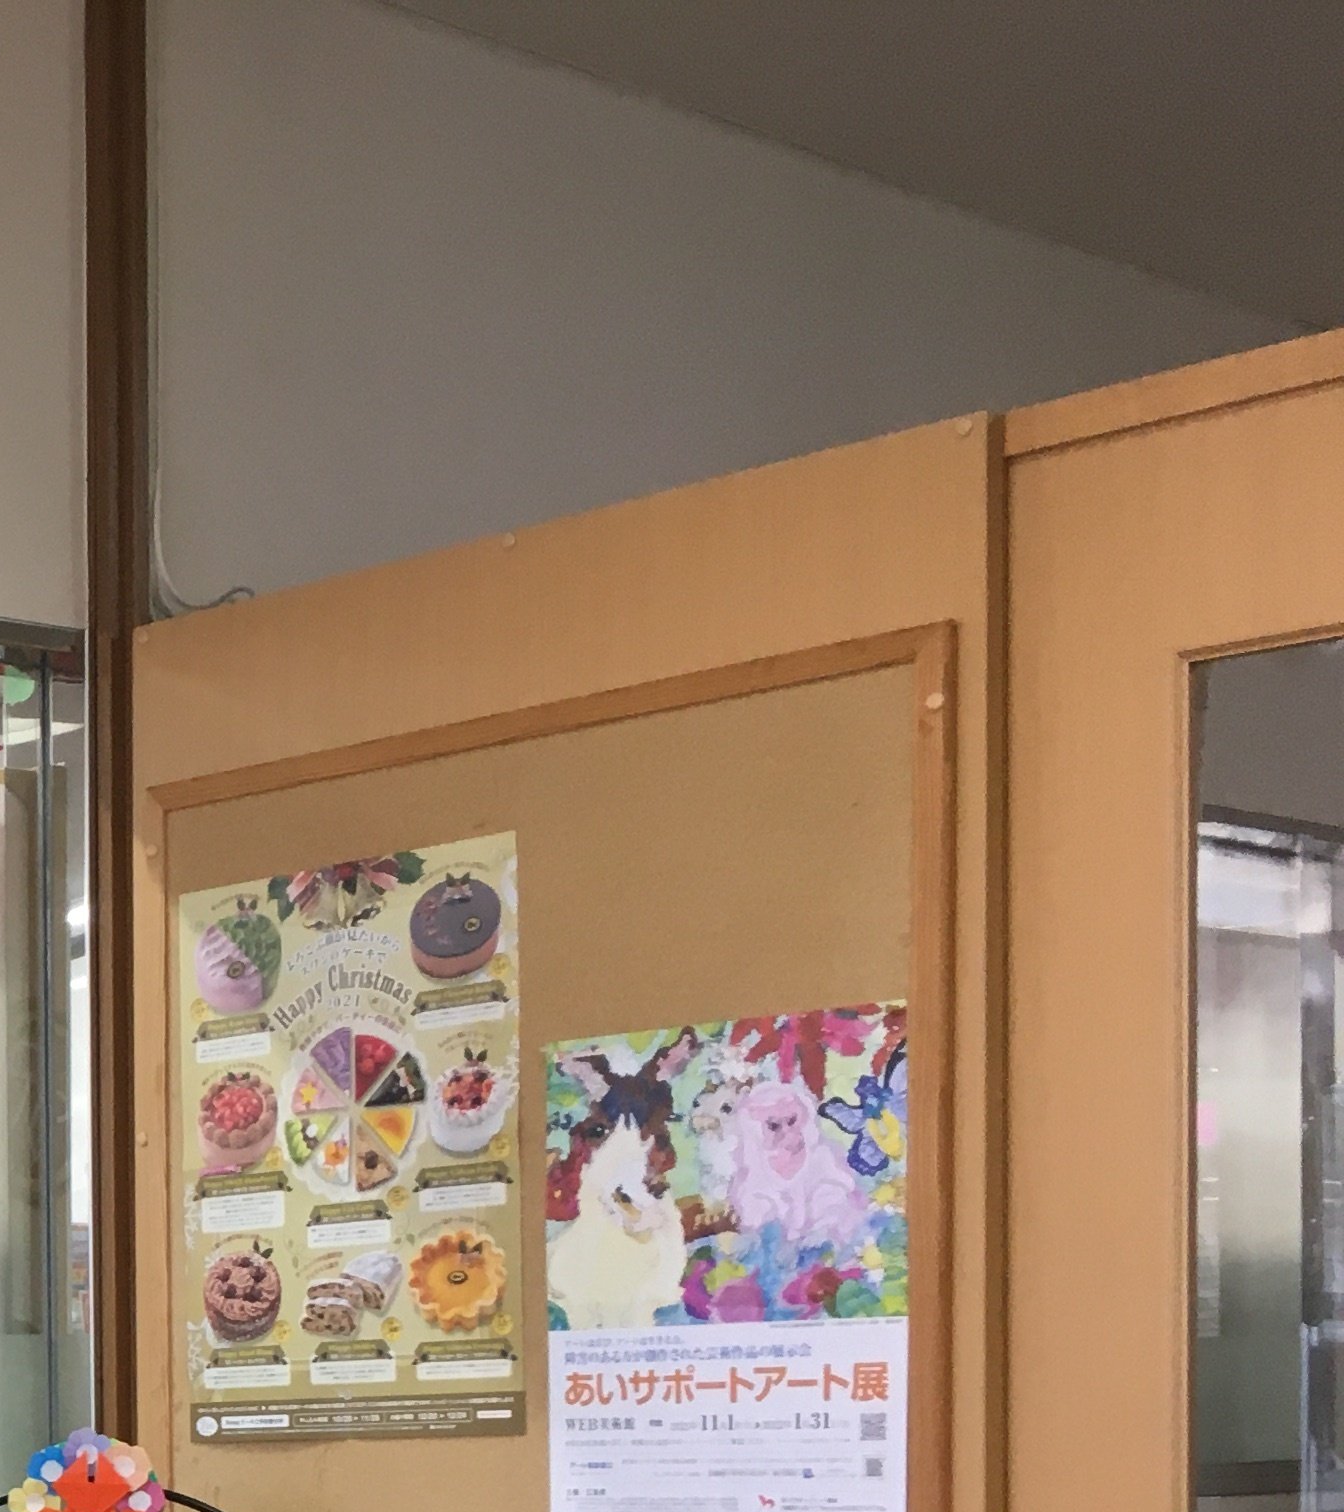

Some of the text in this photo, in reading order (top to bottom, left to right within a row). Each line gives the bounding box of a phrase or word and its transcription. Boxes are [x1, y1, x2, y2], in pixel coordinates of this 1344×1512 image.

[273, 981, 323, 1030] Happy
[328, 962, 413, 1005] Christmas
[564, 1361, 889, 1407] あいサポートアート展
